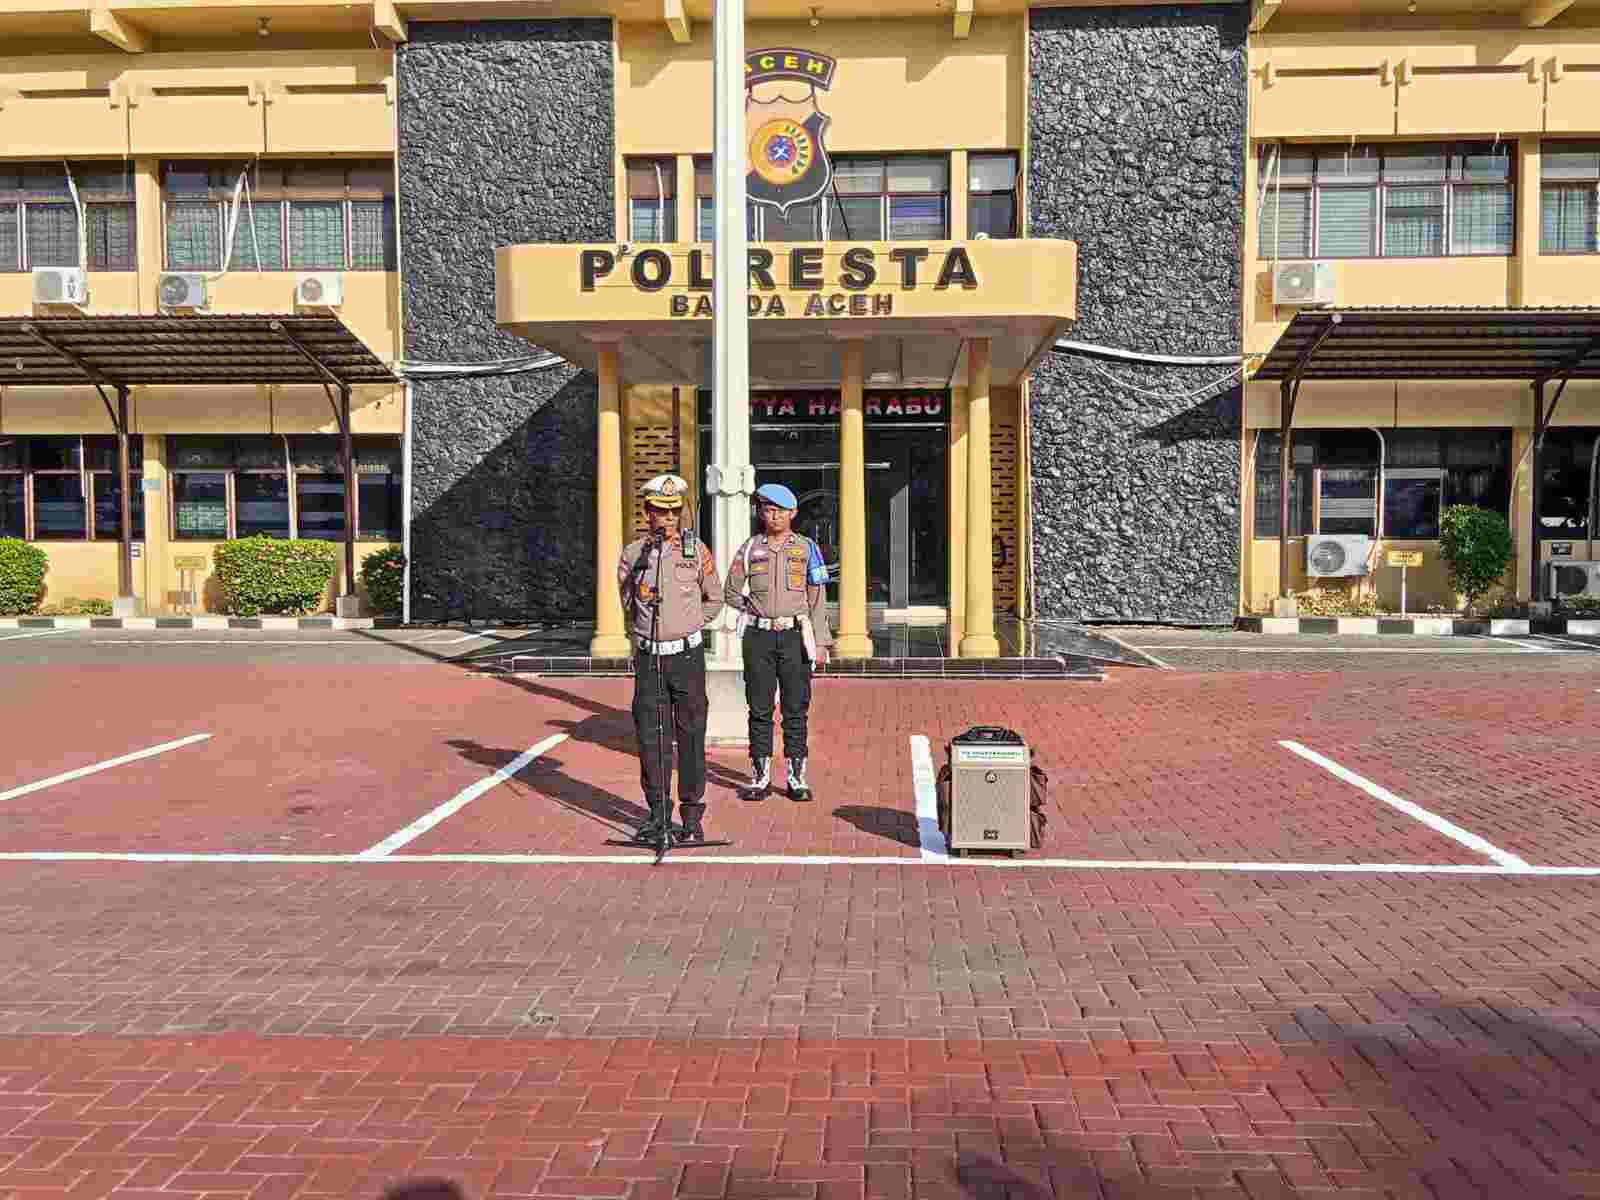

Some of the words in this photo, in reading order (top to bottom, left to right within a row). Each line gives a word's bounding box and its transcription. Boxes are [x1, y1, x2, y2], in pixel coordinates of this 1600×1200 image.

[581, 248, 977, 292] POLRESTA
[671, 294, 785, 317] BADA
[804, 293, 893, 316] ACEH
[808, 394, 944, 416] HARABU
